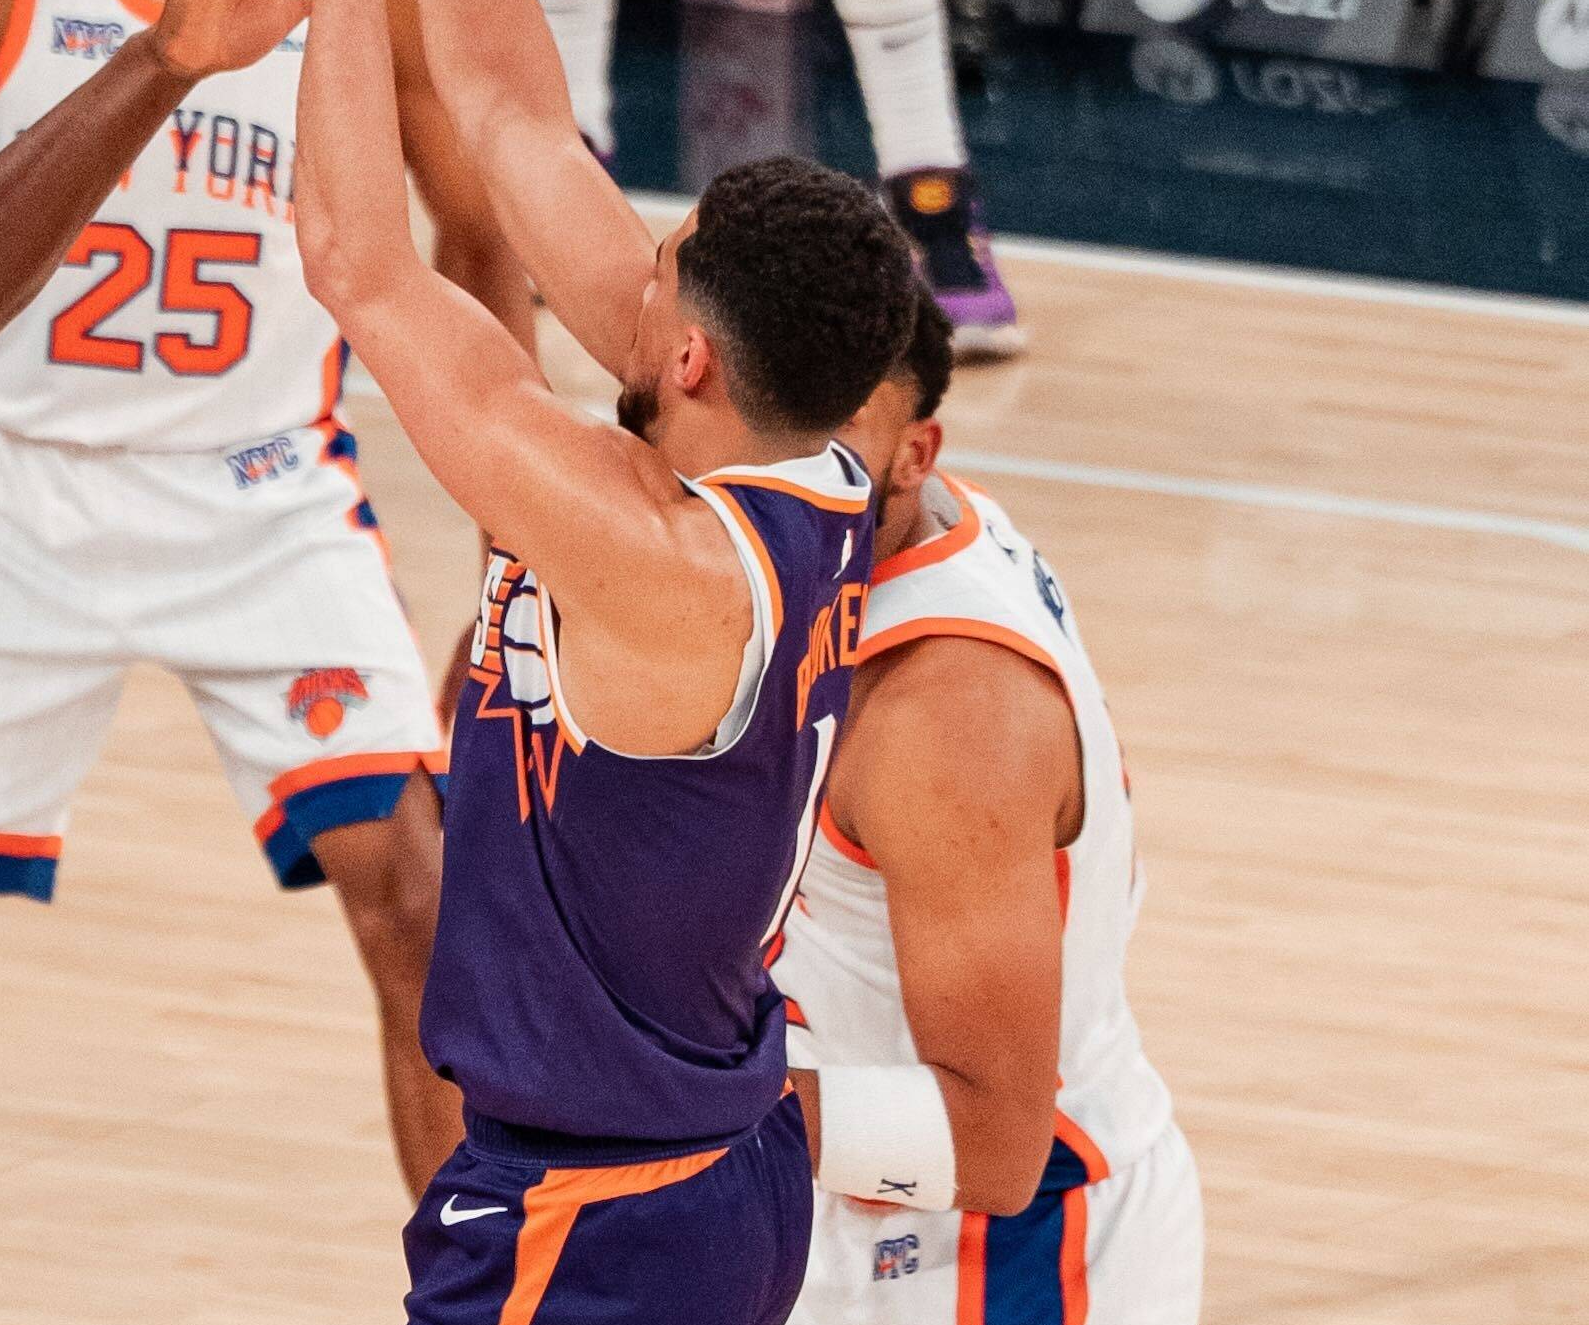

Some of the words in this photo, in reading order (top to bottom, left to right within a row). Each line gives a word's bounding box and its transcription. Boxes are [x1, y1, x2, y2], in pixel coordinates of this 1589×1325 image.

[169, 109, 295, 223] YOR
[48, 221, 263, 377] 25
[226, 436, 299, 490] NYC
